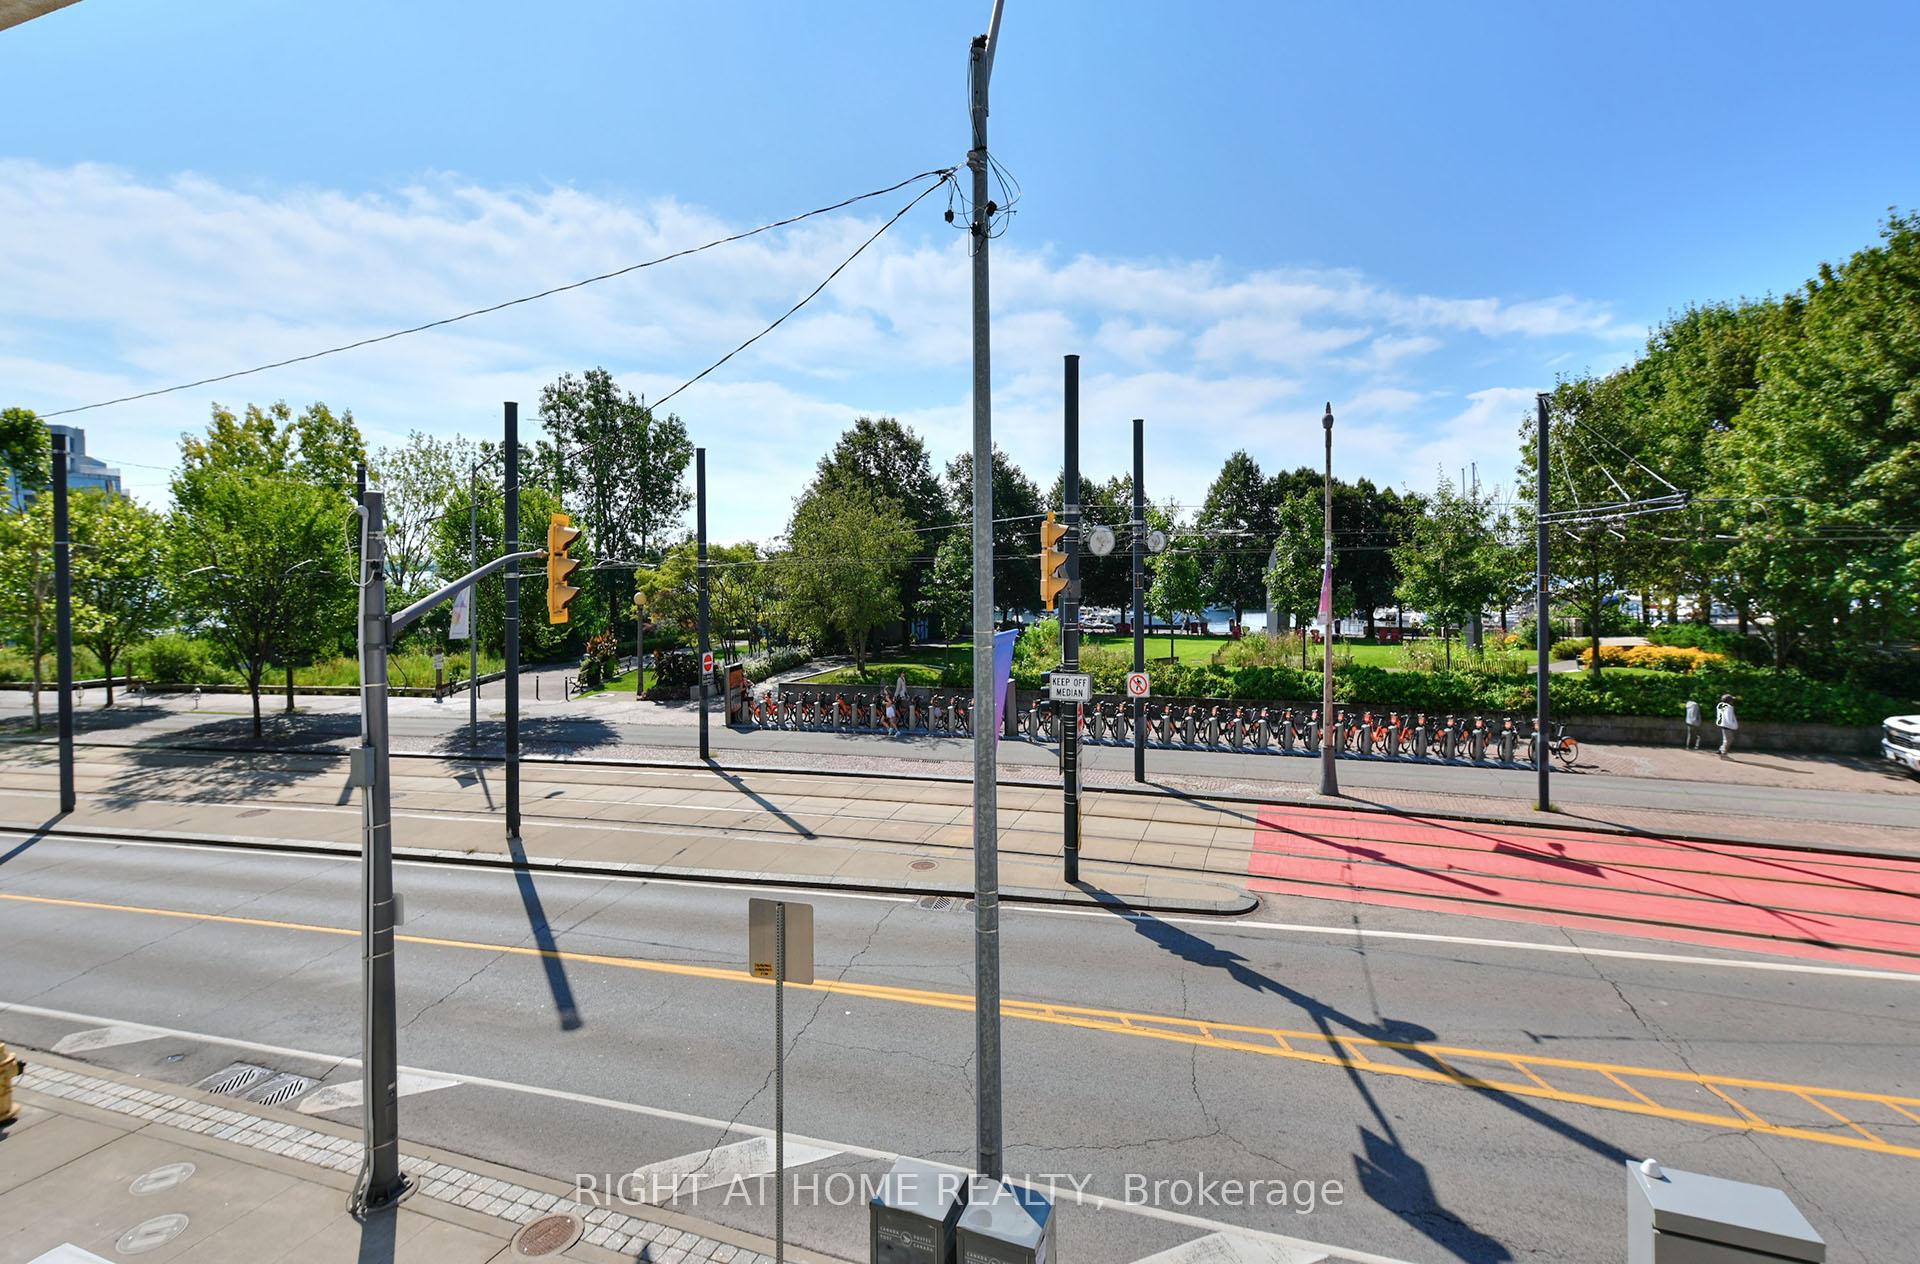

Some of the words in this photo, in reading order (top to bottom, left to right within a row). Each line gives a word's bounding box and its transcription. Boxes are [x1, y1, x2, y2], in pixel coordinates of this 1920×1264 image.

[1052, 677, 1070, 686] KEEP
[1073, 678, 1087, 687] OFF
[1056, 688, 1083, 697] MEDIAN
